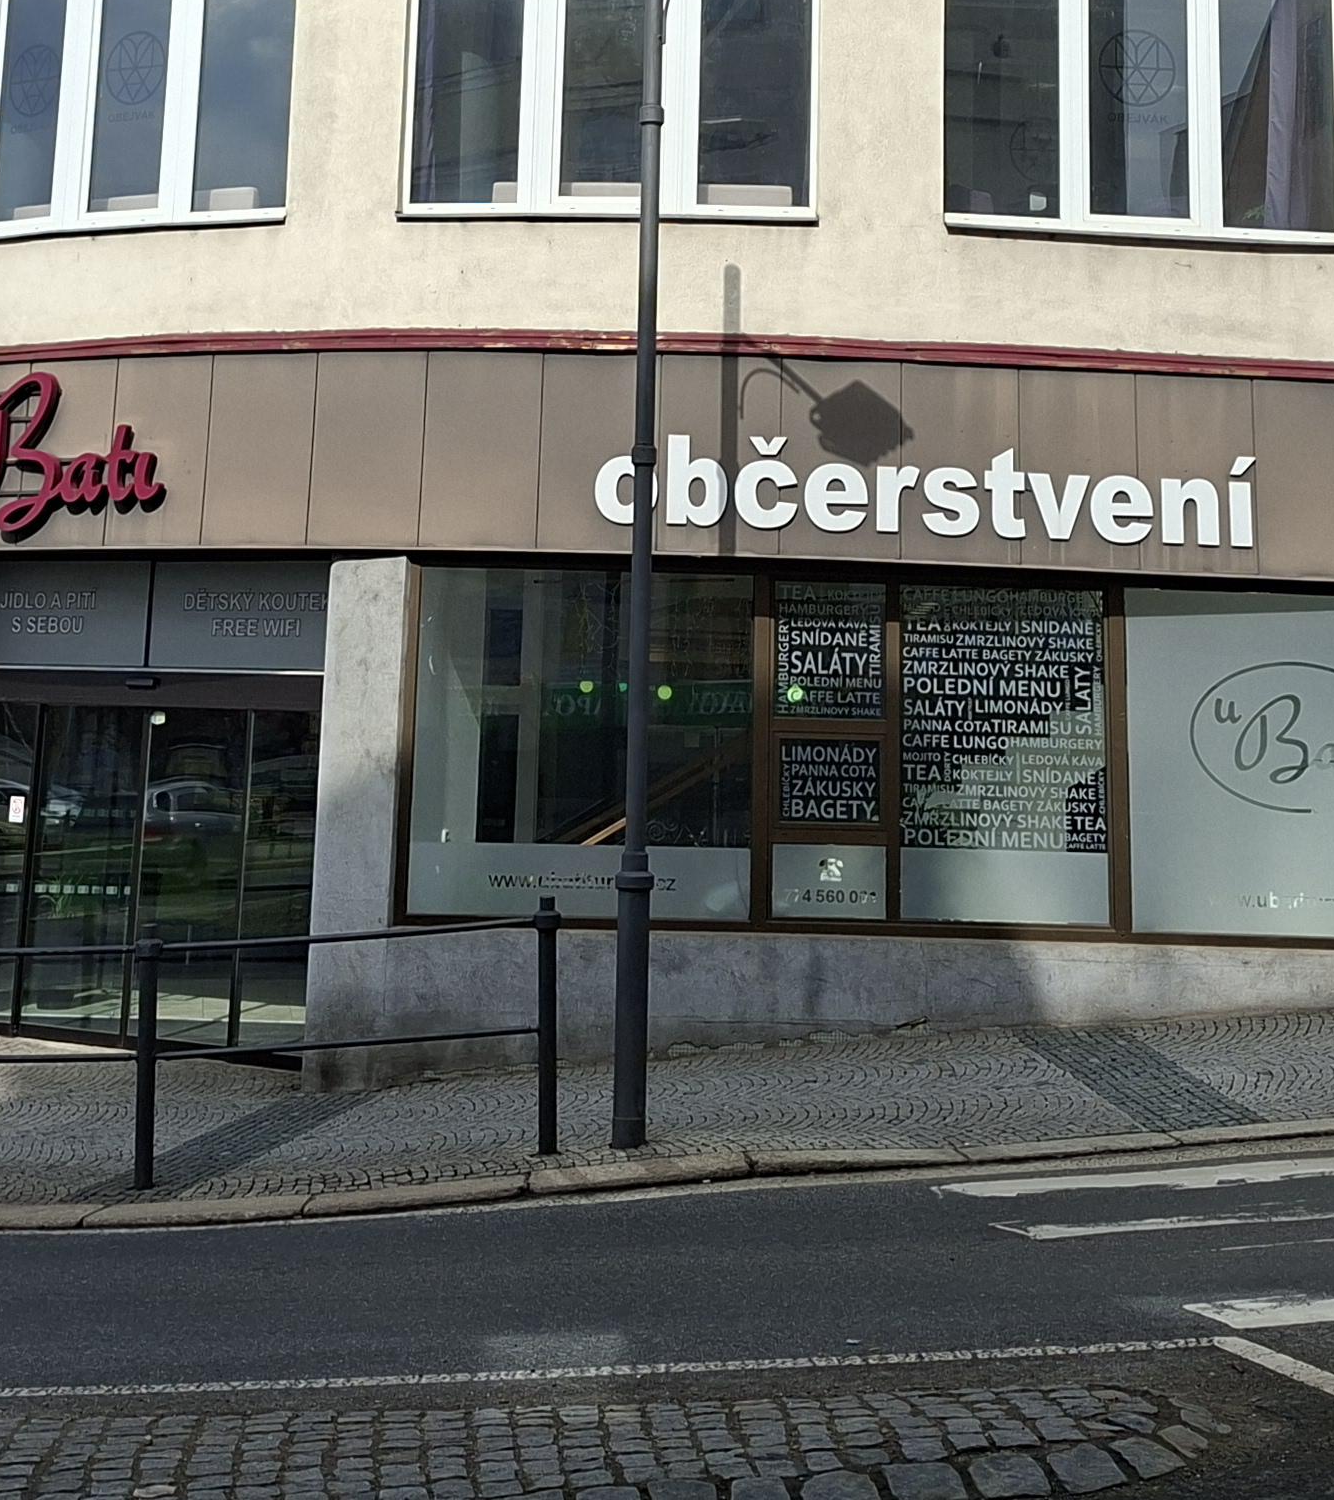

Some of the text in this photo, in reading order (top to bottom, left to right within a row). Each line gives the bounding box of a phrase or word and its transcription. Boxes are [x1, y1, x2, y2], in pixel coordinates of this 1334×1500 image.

[594, 434, 1256, 548] občerstvení
[0, 589, 96, 610] JÍDLO A PITÍ
[183, 589, 255, 611] DĚTSKÝ
[11, 617, 84, 634] S SEBOU
[211, 618, 300, 637] FREE WIFI
[903, 614, 941, 632] TEA
[952, 620, 1011, 632] KOKTEJLY
[790, 629, 868, 647] SNÍDANĚ
[903, 633, 1094, 650] TIRAMISU ZMRZLINOVÝ SHAKE
[790, 647, 868, 676] SALÁTY
[902, 646, 1094, 663] CAFFE LATTE BAGETY ZÁKUSKY
[902, 660, 1069, 679] ZMRZLINOVÝ SHAKE
[790, 675, 882, 689] POLEDNÍ MENU
[903, 676, 1060, 698] POLEDNÍ MENU
[837, 691, 881, 704] LATTE
[851, 707, 882, 716] SHAKE
[903, 697, 965, 718] SALÁTY
[975, 697, 1063, 716] LIMONÁDY
[903, 719, 1071, 735] PANNA COTA TIRAMISU
[902, 733, 1103, 750] CAFFE LUNGO HAMBURGERY
[781, 743, 877, 763] LIMONÁDY
[902, 751, 941, 762] MOJITO
[791, 764, 876, 778] PANNA COTA
[903, 764, 1096, 786] TEA KOKTEJLY SNÍDANĚ
[944, 751, 952, 782] DORTY
[792, 777, 876, 798] ZÁKUSKY
[956, 784, 1047, 798] ZMRZLINOVÝ
[1050, 787, 1096, 800] SHAKE
[791, 799, 876, 820] BAGETY
[983, 799, 1033, 812] BAGETY
[1037, 799, 1096, 814] ZÁKUSKY
[903, 810, 1107, 831] ZMRZLINOVÝ SHAKE TEA
[904, 827, 1106, 849] POLEDNÍ MENU BAGETY
[816, 890, 845, 904] 560
